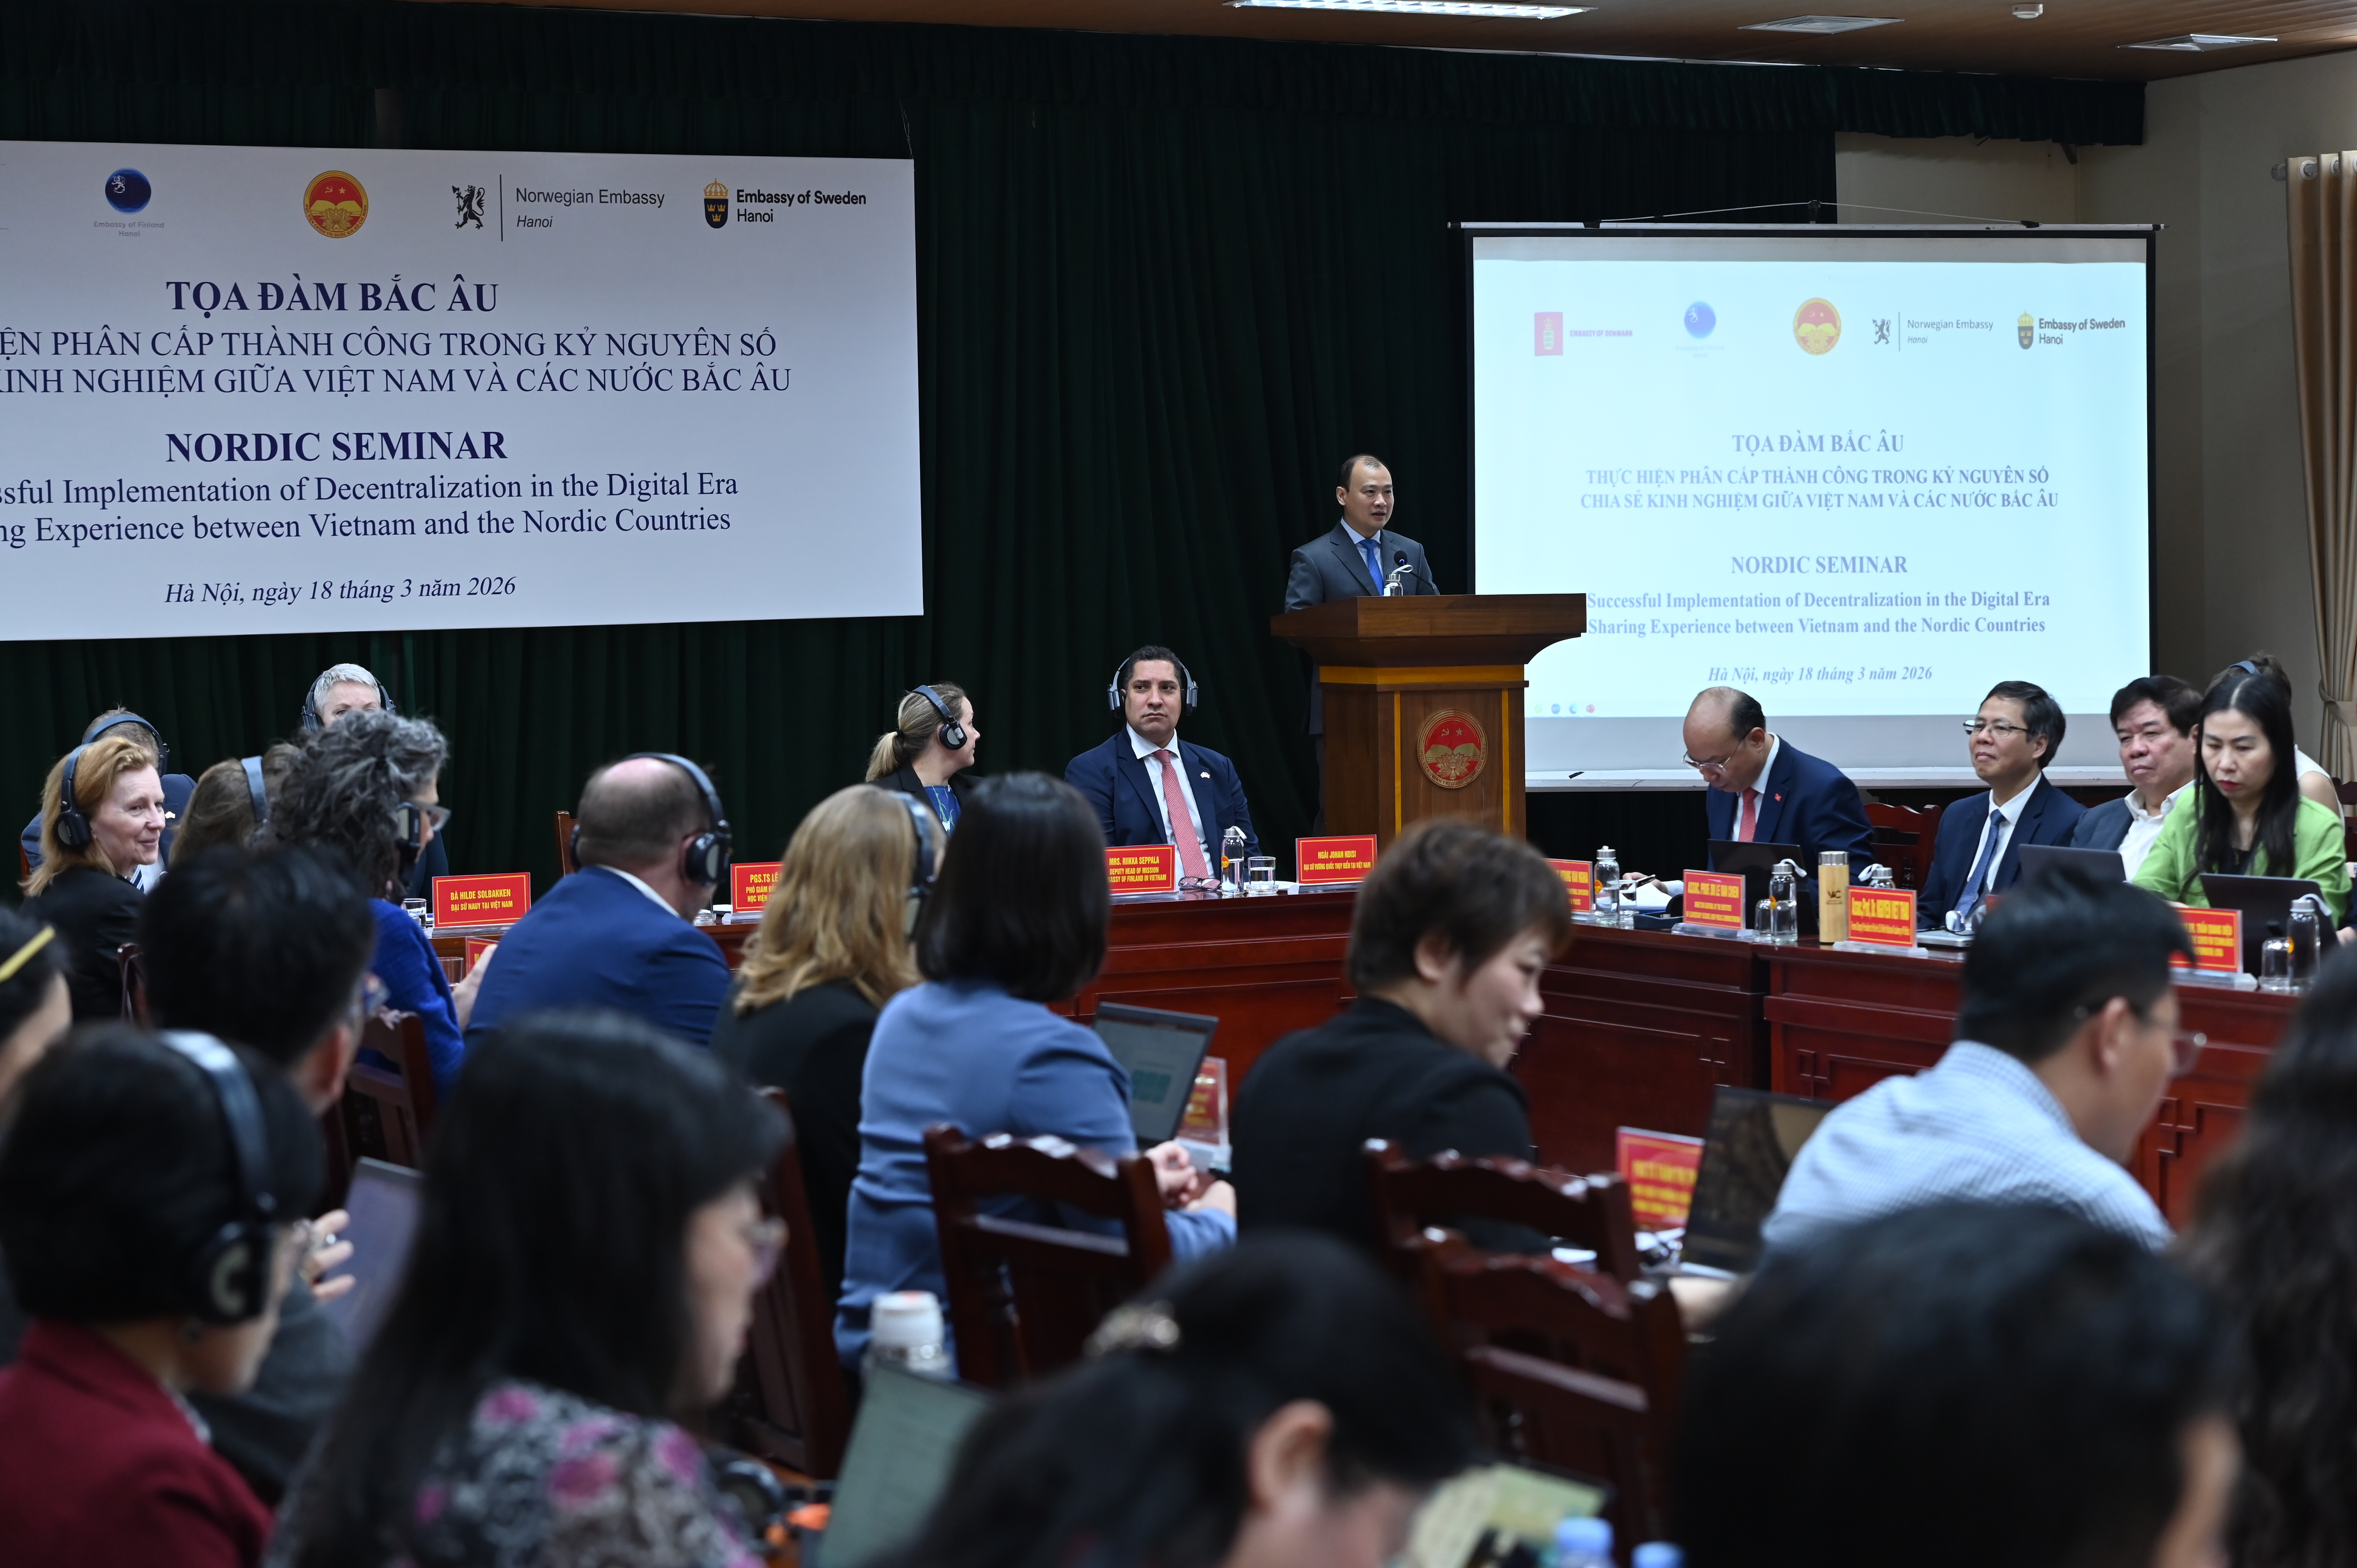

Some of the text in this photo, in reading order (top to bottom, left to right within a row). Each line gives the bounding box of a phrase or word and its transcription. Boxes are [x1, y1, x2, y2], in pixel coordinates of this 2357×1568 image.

[517, 188, 664, 208] Norwegian Embassy
[737, 189, 866, 207] Embassy of Sweden
[517, 215, 552, 227] Hanoi
[738, 209, 773, 222] Hanoi
[166, 274, 498, 318] TỌA ĐÀM BẮC ÂU
[1908, 320, 1993, 331] Norwegian Embassy
[2039, 318, 2125, 333] Embassy of Sweden
[0, 325, 776, 360] ỆN PHÂN CẤP THÀNH CÔNG TRONG KỶ NGUYÊN SỐ
[2039, 334, 2063, 344] Hanoi
[72, 365, 205, 397] NGHIỆM
[215, 364, 297, 392] GIỮA
[304, 365, 374, 397] VIỆT
[383, 369, 456, 392] NAM
[463, 362, 508, 391] VÀ
[517, 362, 578, 391] CÁC
[586, 362, 673, 391] NƯỚC
[682, 362, 741, 391] BẮC
[750, 362, 791, 390] ÂU
[165, 432, 508, 462] NORDIC SEMINAR
[1732, 429, 1903, 456] TỌA ĐÀM BẮC ÂU
[1586, 465, 2048, 487] THỰC HIỆN PHÂN CẤP THÀNH CÔNG TRONG KỶ NGUYÊN SỐ
[63, 478, 271, 509] Implementation
[281, 477, 309, 500] of
[315, 475, 522, 500] Decentralization
[531, 474, 554, 496] in
[562, 473, 598, 496] the
[606, 472, 689, 502] Digital
[697, 473, 738, 494] Era
[1581, 494, 1620, 508] CHIA
[1648, 494, 1687, 507] KINH
[1693, 492, 1757, 511] NGHIỆM
[1763, 491, 1803, 507] GIỮA
[1807, 492, 1843, 511] VIỆT
[1848, 494, 1883, 507] NAM
[1888, 490, 1909, 507] VÀ
[1914, 490, 1946, 507] CÁC
[1951, 490, 1996, 507] NƯỚC
[2002, 490, 2032, 507] BẮC
[2037, 489, 2058, 507] ÂU
[35, 516, 184, 547] Experience
[192, 515, 301, 539] between
[308, 513, 416, 537] Vietnam
[425, 511, 469, 534] and
[477, 510, 514, 533] the
[522, 509, 606, 532] Nordic
[616, 507, 730, 531] Countries
[1732, 556, 1907, 573] NORDIC SEMINAR
[164, 577, 516, 606] Hà Nội, ngày 18 tháng 3 năm 2026
[1588, 592, 2049, 611] Successful Implementation of Decentralization in the Digital Era
[1589, 617, 2045, 637] Sharing Experience between Vietnam and the Nordic Countries
[1709, 667, 1931, 684] Hà Nội, ngày 18 tháng 3 năm 2026
[750, 874, 770, 883] PGS.TS
[451, 889, 511, 900] BÀ HILDE SOLBAKKEN
[491, 900, 500, 909] VIỆT
